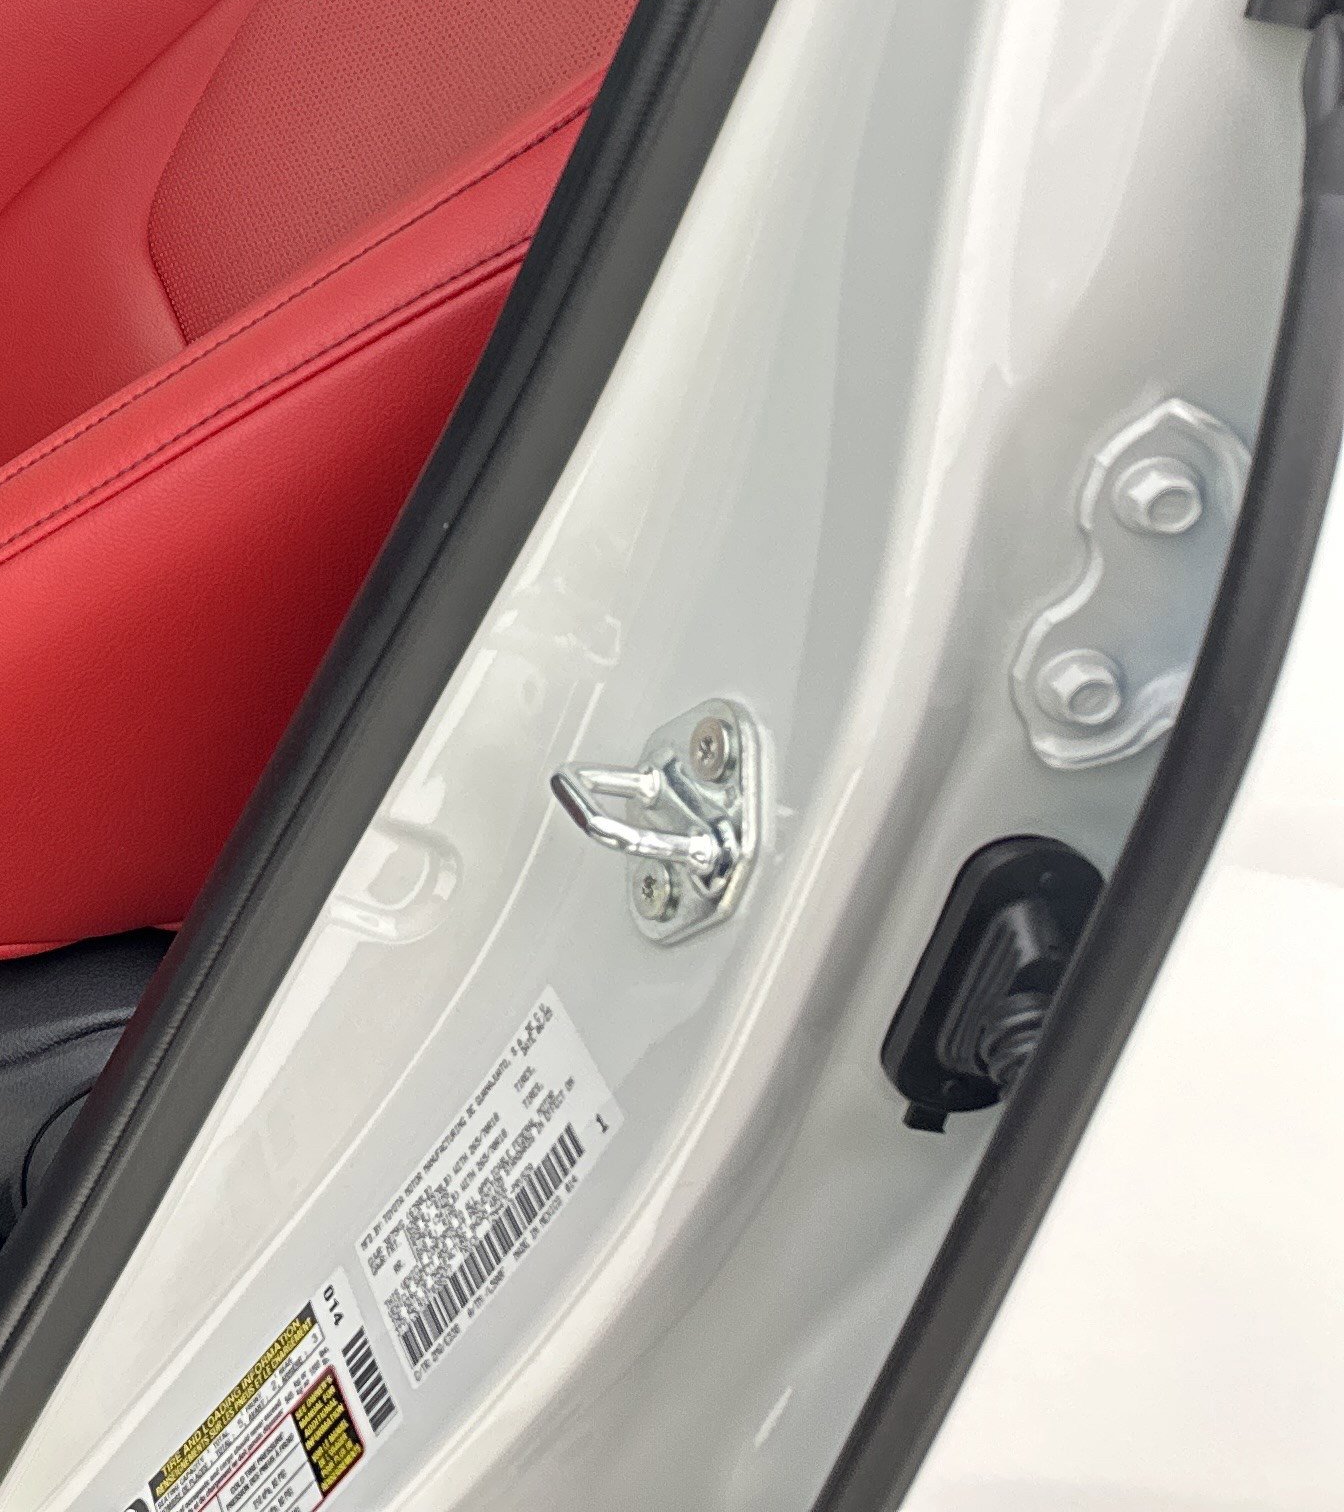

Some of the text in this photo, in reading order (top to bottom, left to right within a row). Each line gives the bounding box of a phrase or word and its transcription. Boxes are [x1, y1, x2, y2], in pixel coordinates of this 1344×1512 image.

[320, 1281, 346, 1328] 014
[154, 1428, 210, 1502] RENSEIGNEMENTS
[221, 1403, 236, 1426] LES
[233, 1381, 256, 1413] PNEUS
[269, 1314, 314, 1372] CHARGEMENT
[161, 1315, 301, 1479] TIRE AND LOADING INFORMATION
